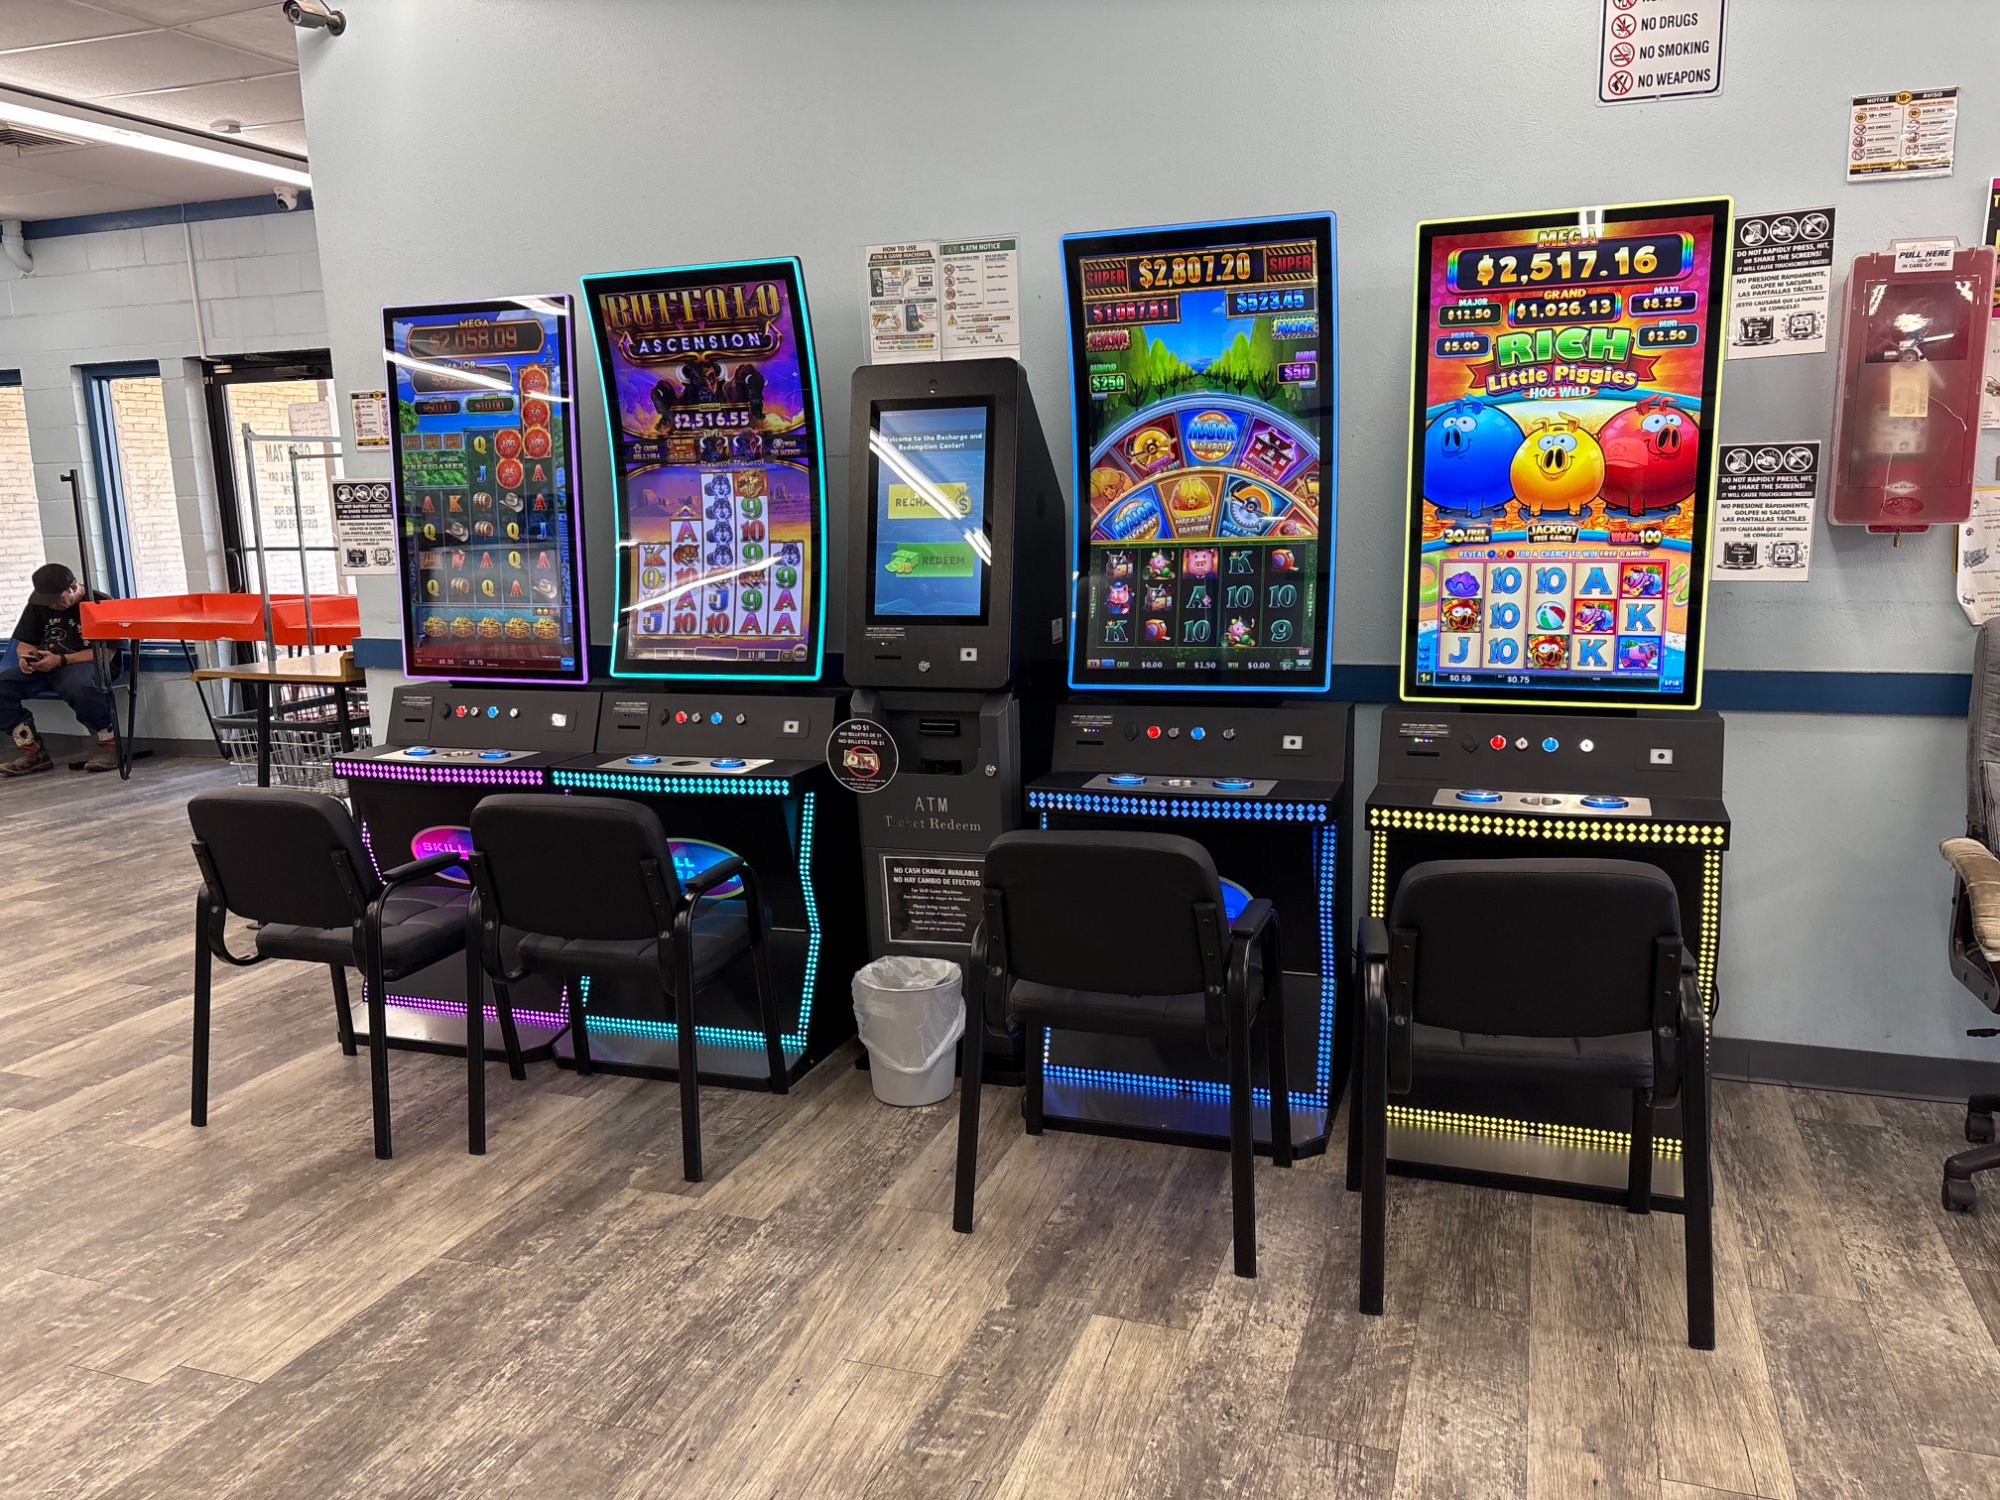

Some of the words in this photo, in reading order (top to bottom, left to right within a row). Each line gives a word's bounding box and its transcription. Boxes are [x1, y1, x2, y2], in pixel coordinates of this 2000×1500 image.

[1641, 17, 1656, 31] NO
[1660, 13, 1698, 29] DRUGS
[1640, 46, 1654, 59] NO
[1658, 40, 1709, 57] SMOKING
[1638, 74, 1653, 88] NO
[1656, 69, 1710, 86] WEAPONS
[1537, 229, 1598, 248] MEGA
[1763, 246, 1791, 255] RAPIDLY
[1791, 251, 1822, 259] SCREENS!
[1270, 255, 1312, 273] SUPER
[1476, 246, 1658, 285] $2,517.16
[1087, 270, 1124, 284] SUPER
[1138, 253, 1250, 289] $2,807.20
[1748, 275, 1779, 283] PRESIONE
[1544, 289, 1586, 299] GRAND
[1654, 286, 1679, 295] MAXI
[1752, 288, 1791, 296] PANTALLAS
[606, 282, 781, 328] BUFFALO
[1237, 290, 1304, 312] $523.45
[1459, 298, 1488, 306] MAJOR
[1643, 297, 1682, 310] $8.25
[1448, 308, 1491, 320] $12.50
[1517, 300, 1611, 318] $1,026.13
[459, 319, 489, 328] MEGA
[1277, 321, 1314, 334] MAJOR
[1648, 330, 1687, 342] $2.50
[639, 333, 760, 354] ASCENSION
[1444, 341, 1479, 351] $5.00
[1497, 328, 1632, 366] RICH
[1285, 365, 1310, 380] $50
[1489, 368, 1548, 391] Little
[1554, 366, 1636, 385] Piggies
[1093, 376, 1124, 391] $250
[1530, 388, 1556, 398] HOG
[674, 412, 749, 428] $2,516.55
[936, 434, 968, 442] Recharge
[1188, 423, 1237, 440] MAJOR
[1193, 442, 1228, 451] JACKPOT
[1445, 529, 1465, 543] 30
[1529, 526, 1577, 535] JACKPOT
[1640, 530, 1661, 543] 100
[922, 556, 965, 564] REDEEM
[1491, 567, 1522, 594] 10
[1536, 567, 1566, 594] 10
[1579, 567, 1612, 594] A
[1626, 604, 1656, 631] K
[1449, 637, 1470, 663] J
[1248, 661, 1270, 669] $0.00
[1507, 676, 1529, 684] $0.75
[915, 796, 948, 812] ATM
[930, 818, 981, 831] Redeem
[423, 842, 467, 853] SKILL
